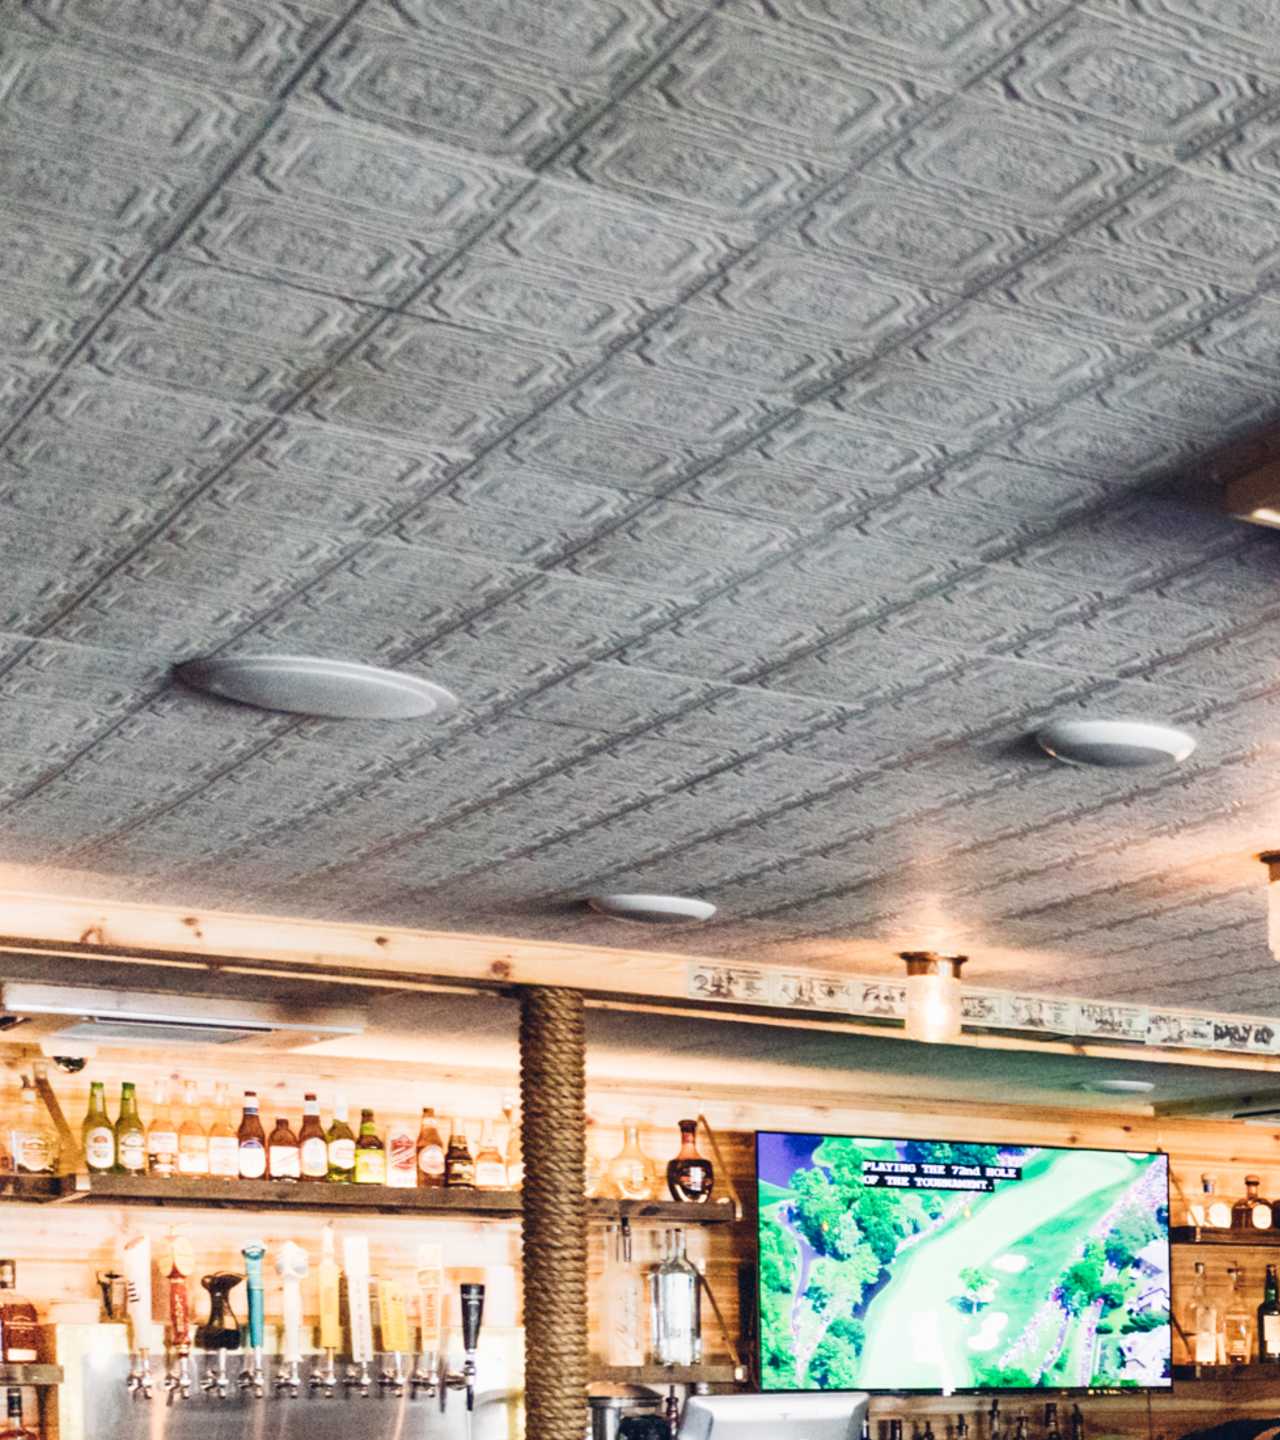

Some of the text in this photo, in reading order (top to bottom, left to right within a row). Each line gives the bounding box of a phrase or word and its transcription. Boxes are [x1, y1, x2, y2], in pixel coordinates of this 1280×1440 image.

[862, 1161, 1017, 1178] PLAYING THE 72nd HOLE
[863, 1174, 880, 1185] OF
[884, 1175, 910, 1186] THE
